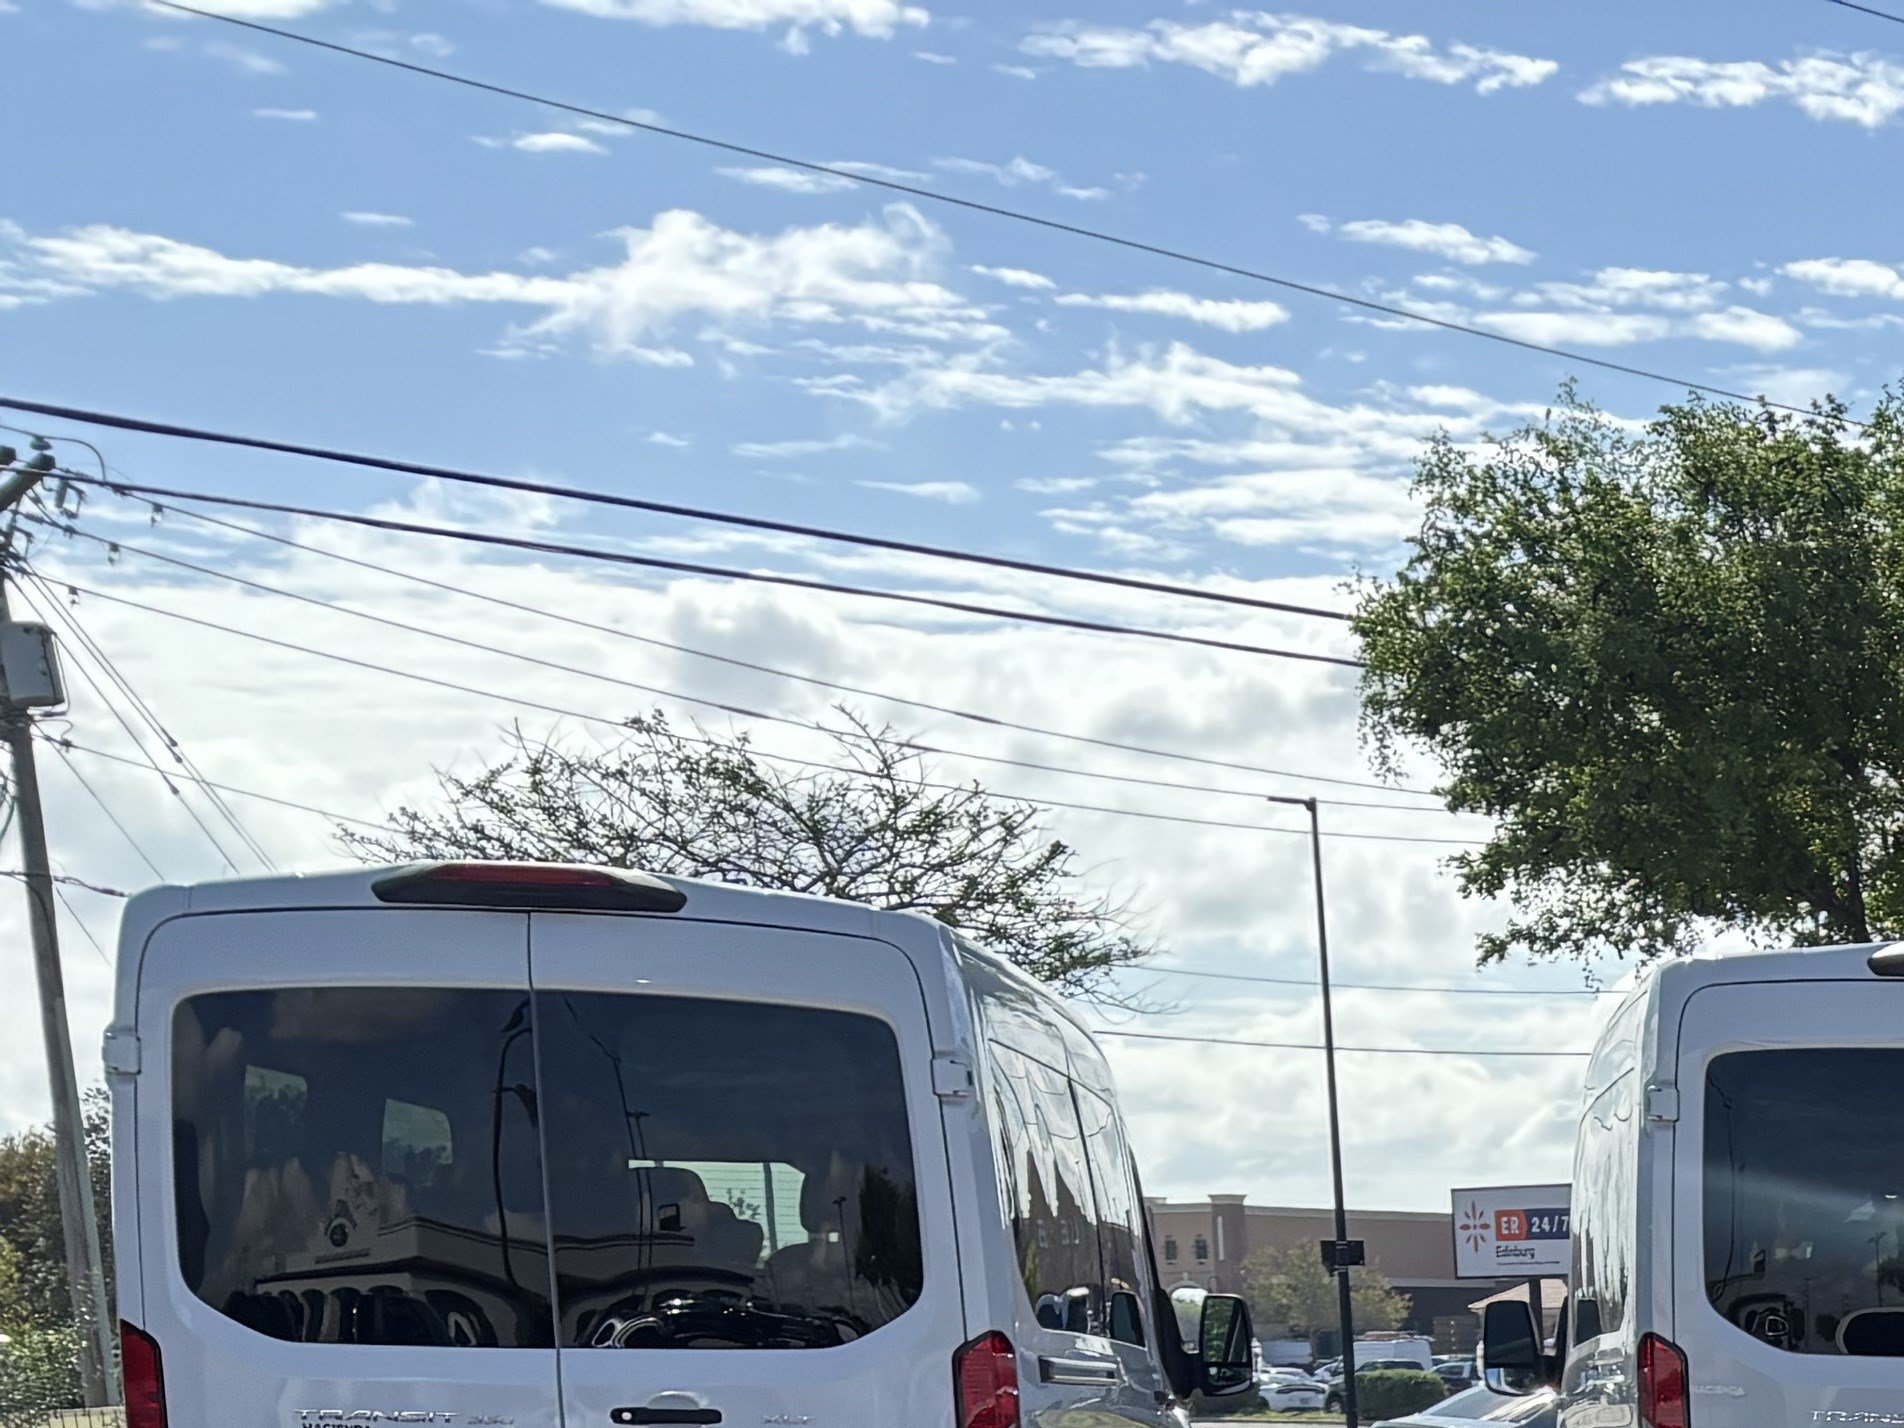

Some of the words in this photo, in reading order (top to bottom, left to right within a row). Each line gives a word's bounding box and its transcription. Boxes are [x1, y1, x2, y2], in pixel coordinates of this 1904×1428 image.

[1501, 1217, 1519, 1234] ER
[1531, 1215, 1568, 1233] 24/7
[294, 1409, 460, 1423] TRANSIT
